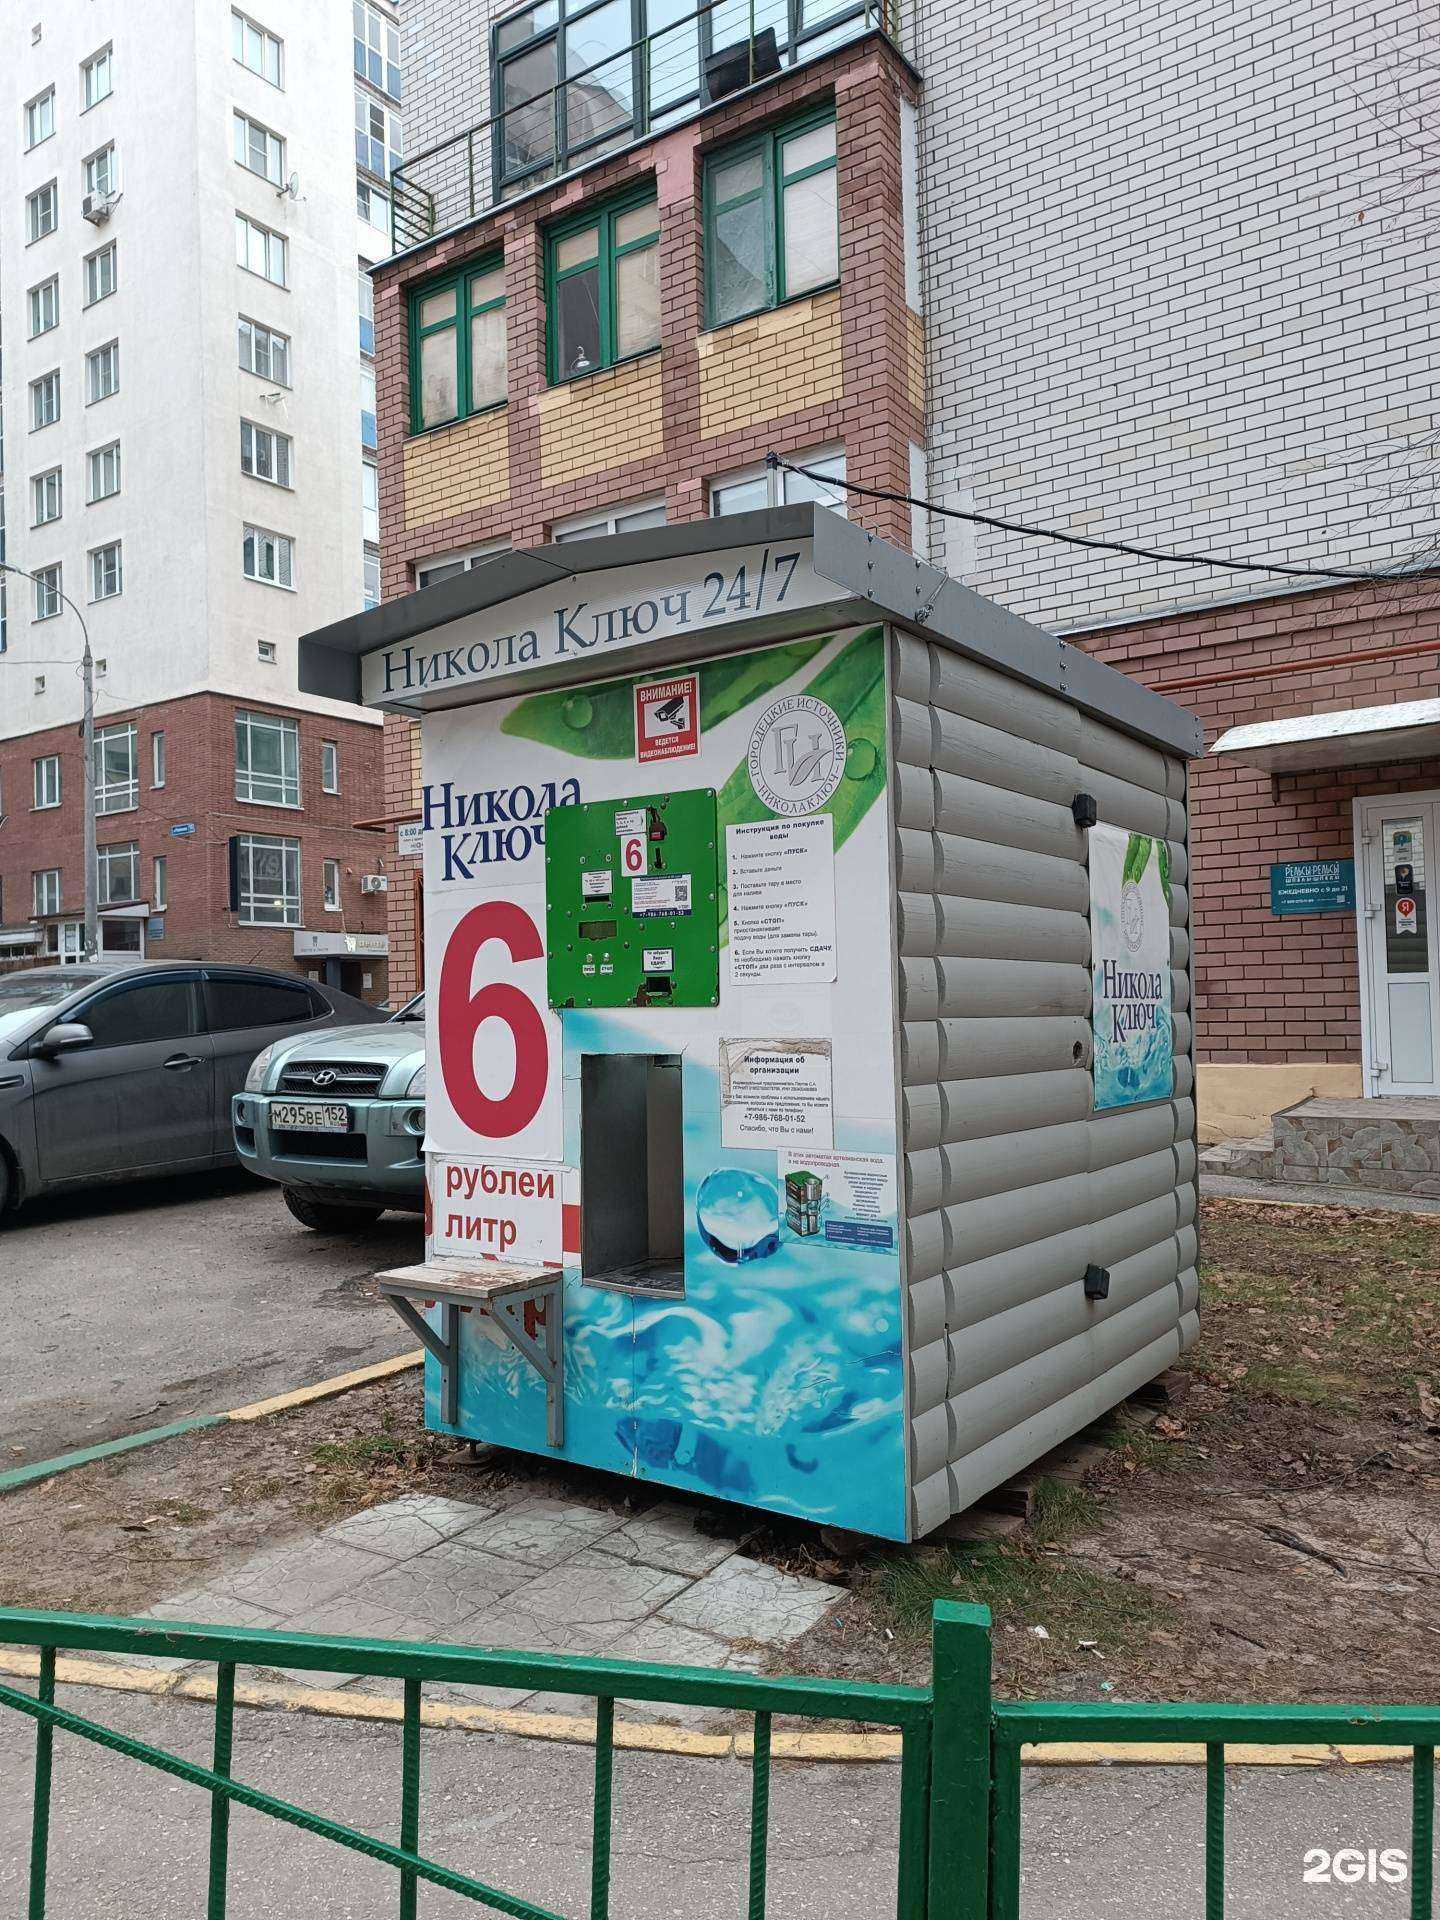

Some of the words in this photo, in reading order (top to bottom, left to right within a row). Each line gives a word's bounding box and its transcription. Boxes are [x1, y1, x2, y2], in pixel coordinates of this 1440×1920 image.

[382, 630, 539, 693] Никола
[554, 602, 692, 656] Ключ
[702, 548, 801, 619] 24/7
[640, 683, 692, 701] ВНИМАНИЕ!
[640, 744, 696, 758] ВИДЕОНАБЛЮДЕНИЕ!
[655, 738, 679, 746] ВЕДЕТСЯ
[750, 699, 794, 777] ГОРОДЕЦКИЕ
[797, 698, 844, 761] ИСТОЧНИКИ
[422, 778, 581, 831] Никола
[736, 824, 779, 834] Инструкция
[793, 819, 824, 829] покупке
[626, 839, 642, 871] 6
[1103, 960, 1162, 1000] Никола
[438, 901, 548, 1138] 6
[1112, 1003, 1156, 1043] Ключ
[744, 1056, 794, 1064] Информация
[325, 1107, 346, 1121] 152
[446, 1214, 517, 1252] литр
